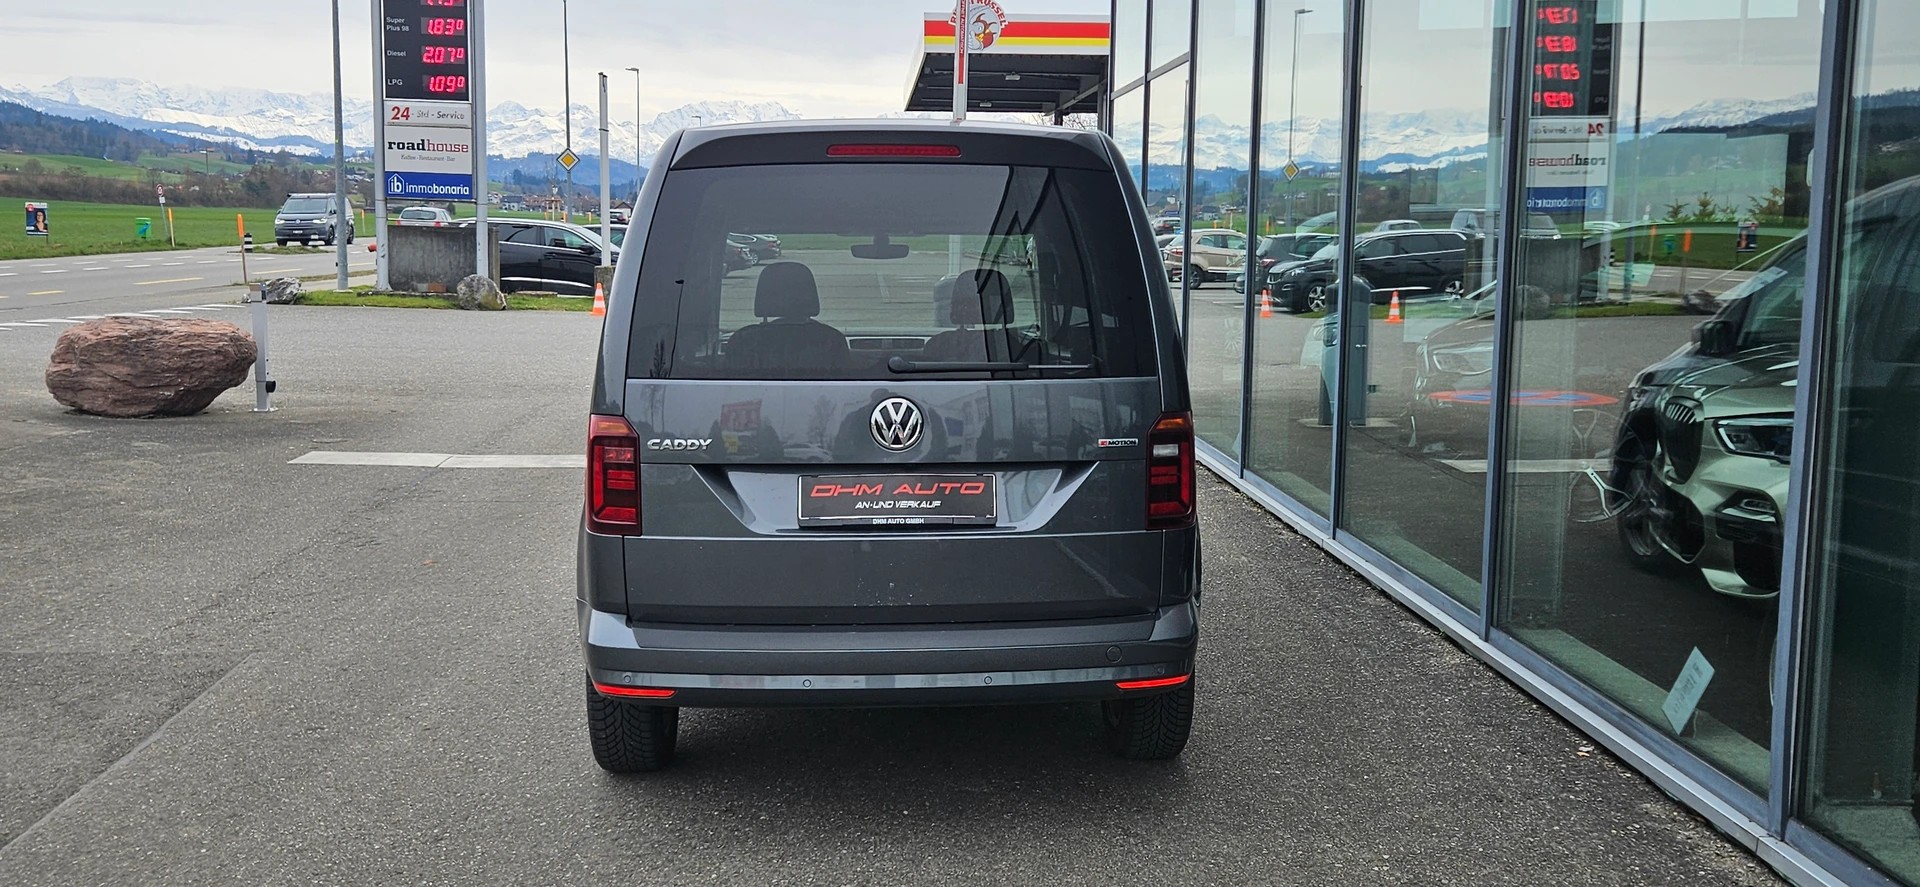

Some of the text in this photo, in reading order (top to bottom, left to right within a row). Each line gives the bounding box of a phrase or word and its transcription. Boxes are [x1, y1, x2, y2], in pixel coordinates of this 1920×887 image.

[386, 16, 405, 24] Super
[391, 106, 410, 120] 24
[436, 111, 464, 119] Service
[388, 139, 468, 152] roadhouse
[405, 182, 469, 195] immobonaria
[646, 438, 713, 451] CADDY
[811, 482, 985, 497] DHM AUTO
[895, 500, 941, 508] VERKAUF
